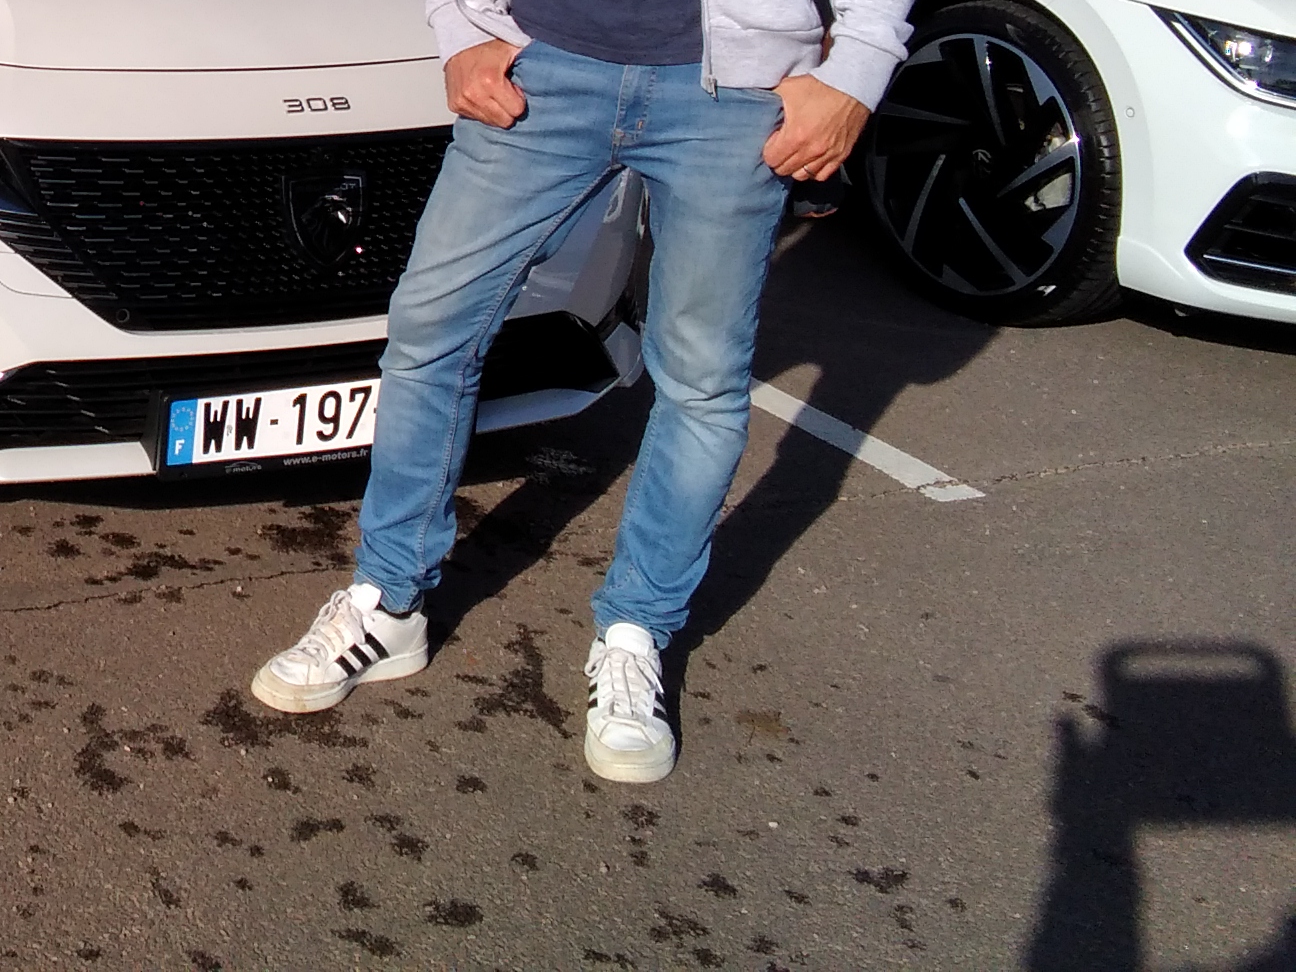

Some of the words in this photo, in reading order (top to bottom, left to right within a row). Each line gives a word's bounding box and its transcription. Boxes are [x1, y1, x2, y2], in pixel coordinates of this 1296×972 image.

[282, 96, 351, 113] 308
[174, 438, 186, 456] F
[283, 448, 369, 466] www.e-motors.fr
